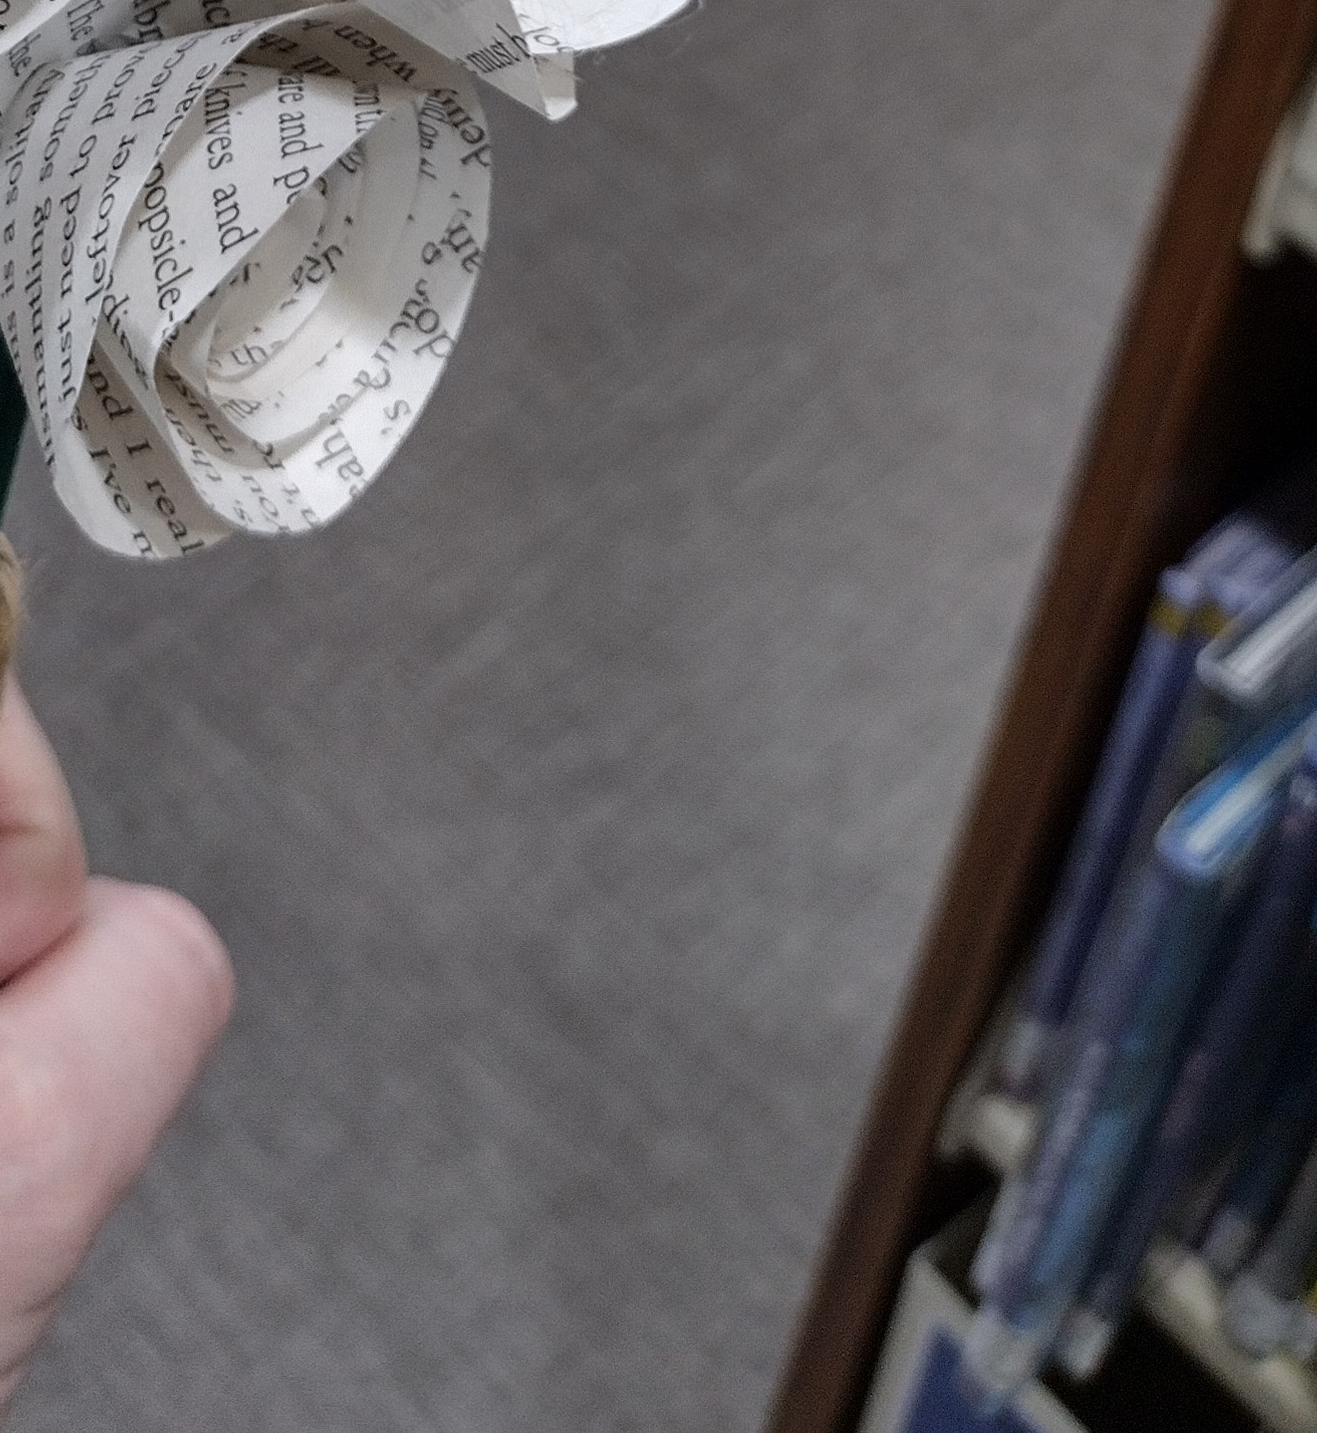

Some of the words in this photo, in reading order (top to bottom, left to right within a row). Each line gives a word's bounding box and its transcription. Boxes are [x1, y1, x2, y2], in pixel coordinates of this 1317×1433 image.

[69, 133, 98, 179] to
[202, 80, 246, 171] knives
[277, 111, 325, 159] and
[59, 187, 82, 299] need
[84, 132, 137, 305] leftover
[212, 183, 259, 255] and
